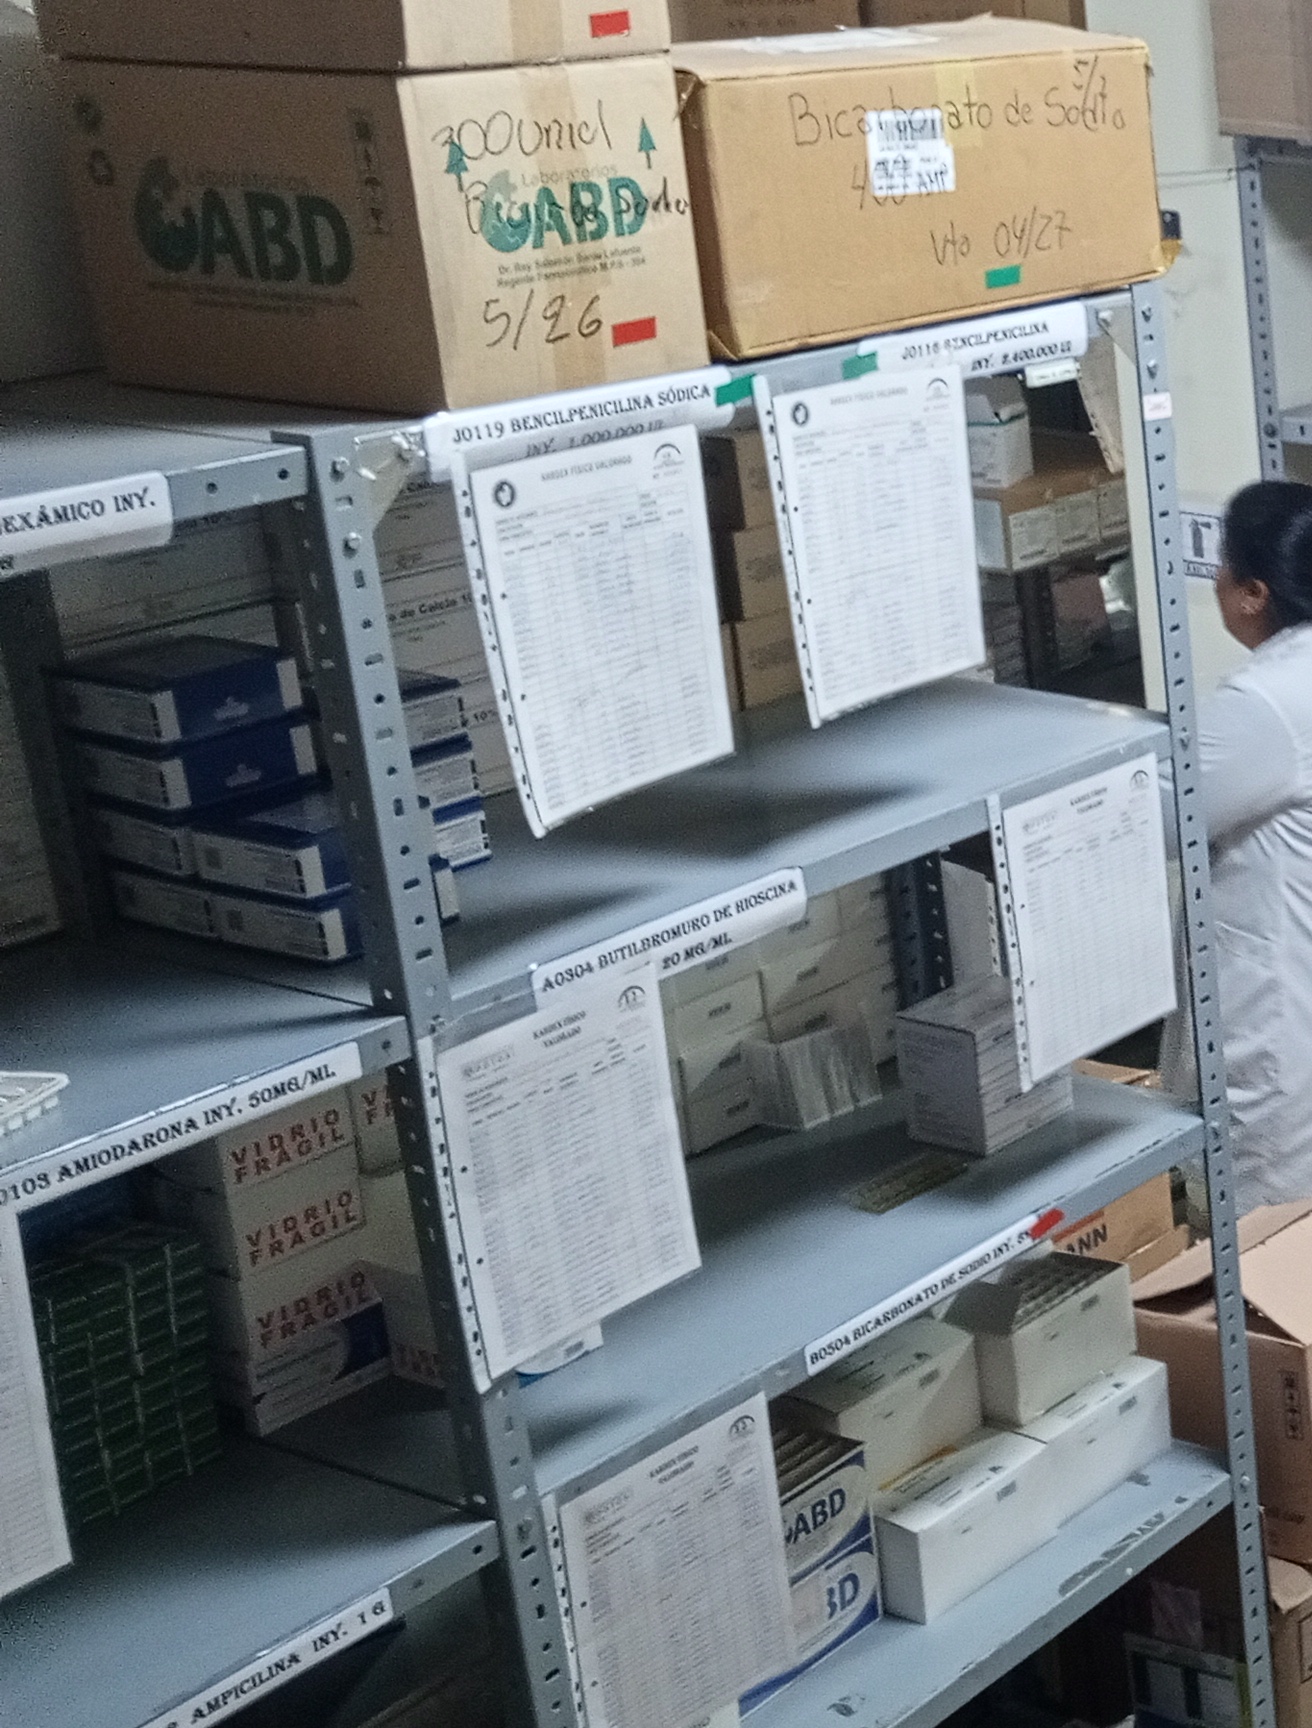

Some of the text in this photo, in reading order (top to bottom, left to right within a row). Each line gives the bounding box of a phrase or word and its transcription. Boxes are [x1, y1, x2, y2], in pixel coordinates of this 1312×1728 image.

[1005, 91, 1035, 128] de
[657, 384, 711, 407] SÓDICA
[0, 486, 156, 536] EXÁMICO INY.
[713, 904, 733, 924] DE
[56, 1116, 200, 1184] AMIODARONA
[205, 1097, 243, 1128] INY.
[248, 1064, 337, 1108] 50MG/ML
[230, 1108, 341, 1166] VIDRIO
[233, 1127, 345, 1185] FRAGIL
[245, 1190, 354, 1249] VIDRIO
[190, 1652, 302, 1725] AMPICILINA
[311, 1622, 349, 1654] INY.
[370, 1598, 387, 1616] G
